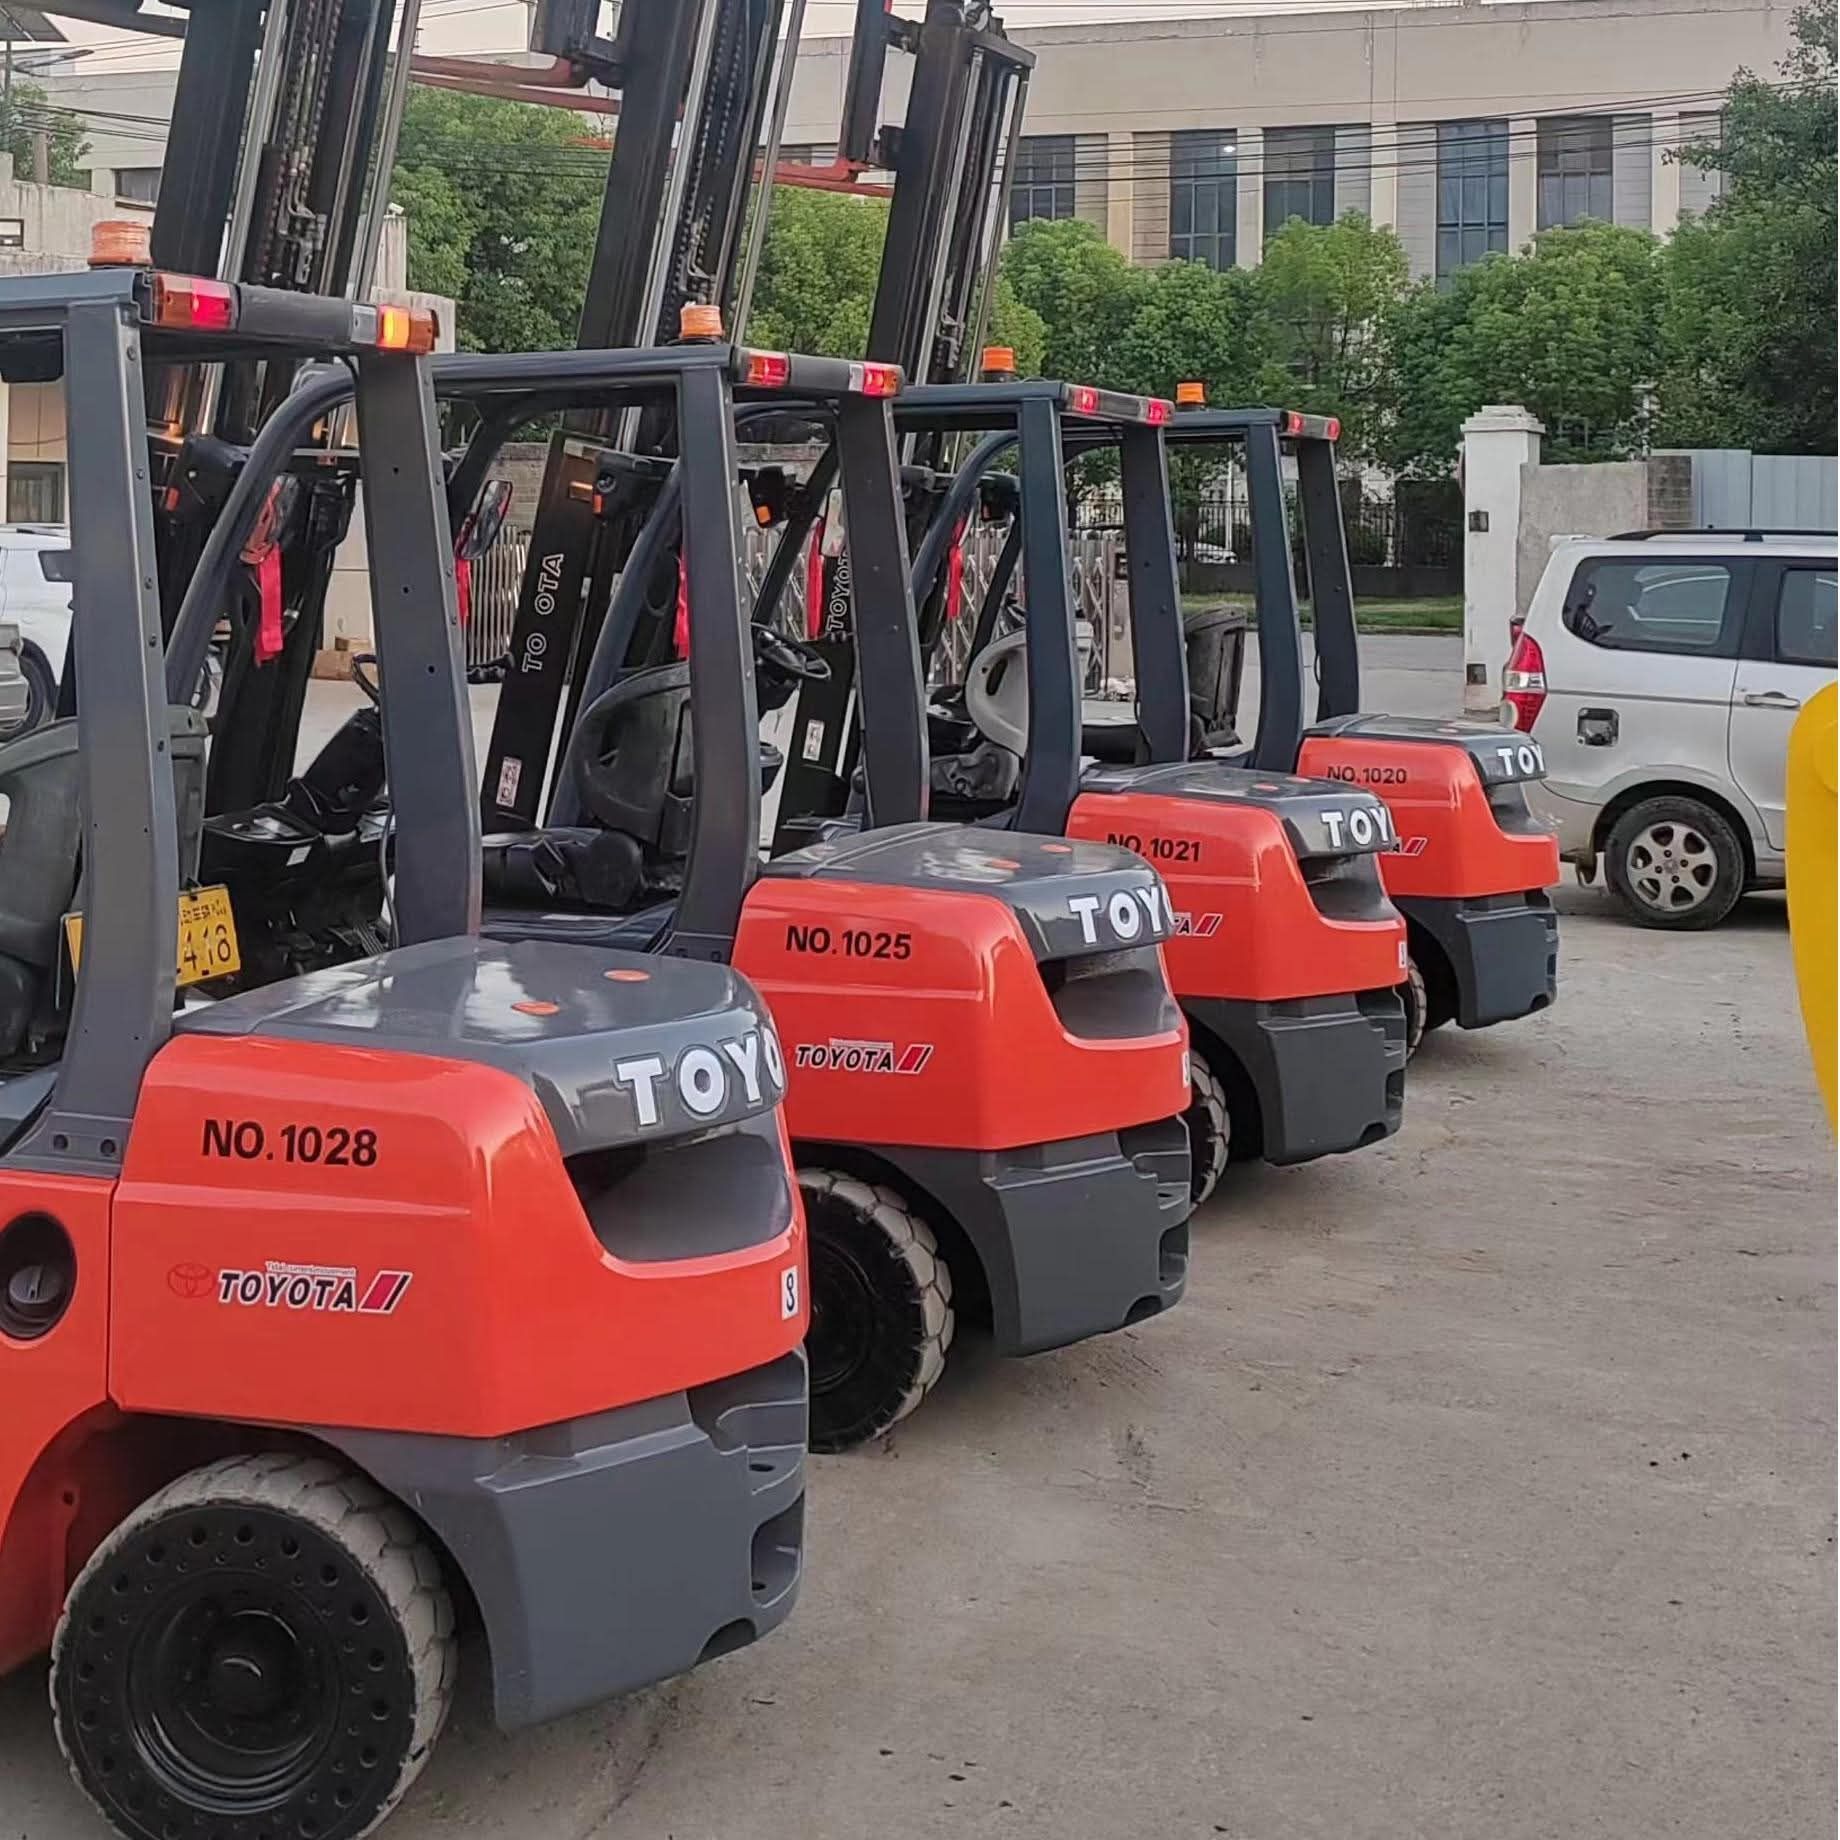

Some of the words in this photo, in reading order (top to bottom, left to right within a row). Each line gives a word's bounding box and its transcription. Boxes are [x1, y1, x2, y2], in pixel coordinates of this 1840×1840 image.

[1327, 765, 1408, 785] NO.1020
[1497, 744, 1545, 776] TOY
[1107, 832, 1200, 863] NO.1021
[785, 925, 912, 960] NO.1025
[797, 1046, 892, 1072] TOYOTA
[616, 1027, 784, 1126] TOYO
[202, 1119, 378, 1168] NO.1028
[219, 1271, 355, 1310] TOYOTA
